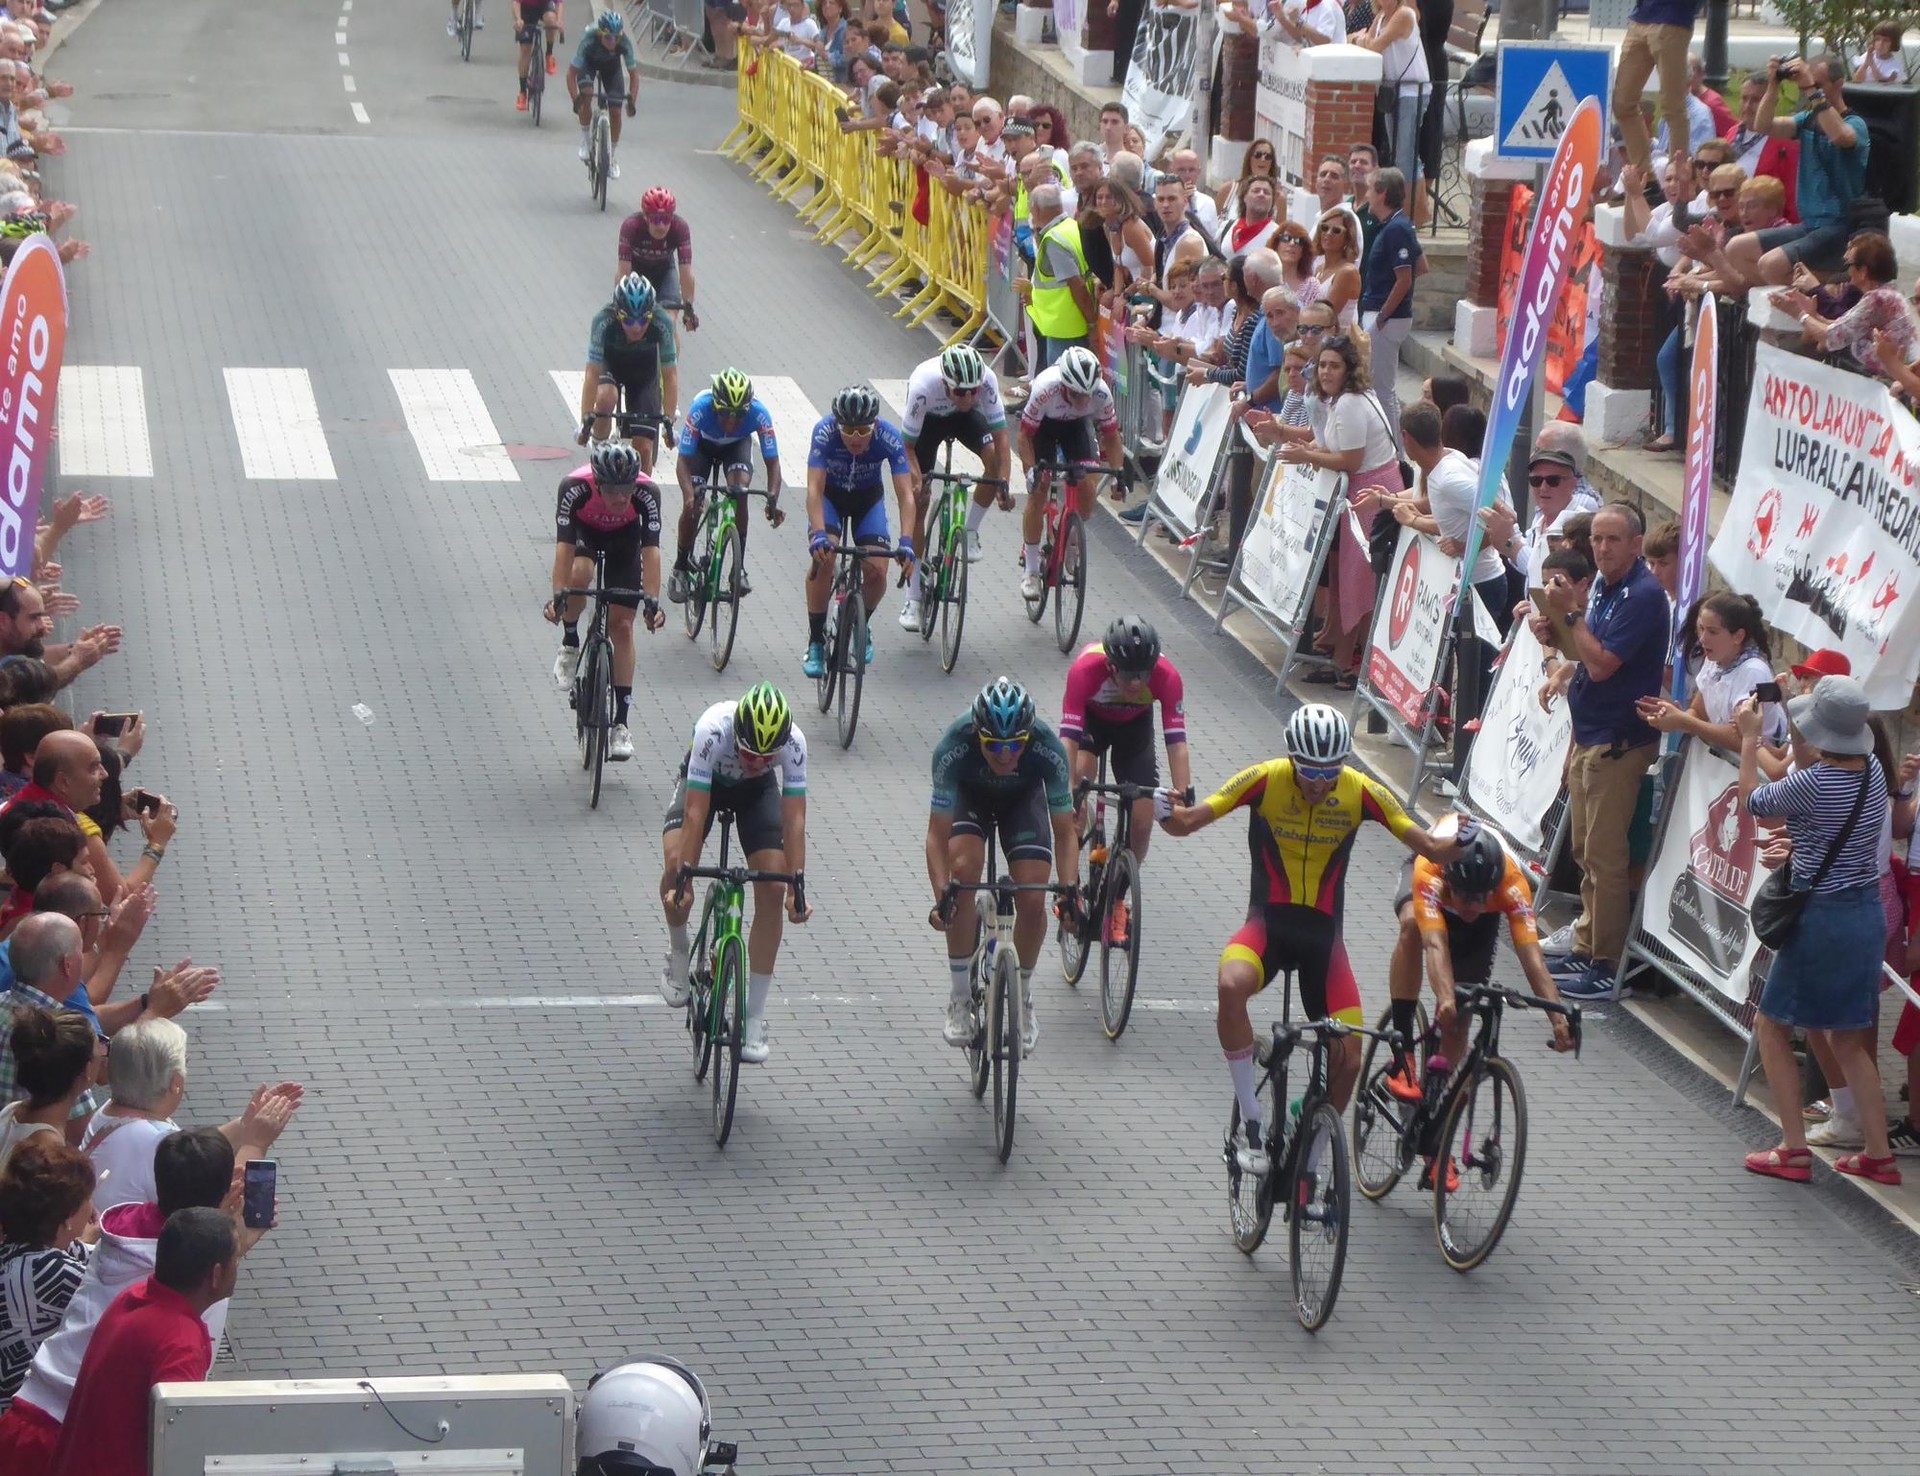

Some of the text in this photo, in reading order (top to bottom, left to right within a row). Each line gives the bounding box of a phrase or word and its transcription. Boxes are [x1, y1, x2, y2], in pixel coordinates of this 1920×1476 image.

[1540, 141, 1574, 246] te amo
[7, 293, 27, 377] amo
[1507, 162, 1583, 411] adamo
[0, 314, 49, 579] damo
